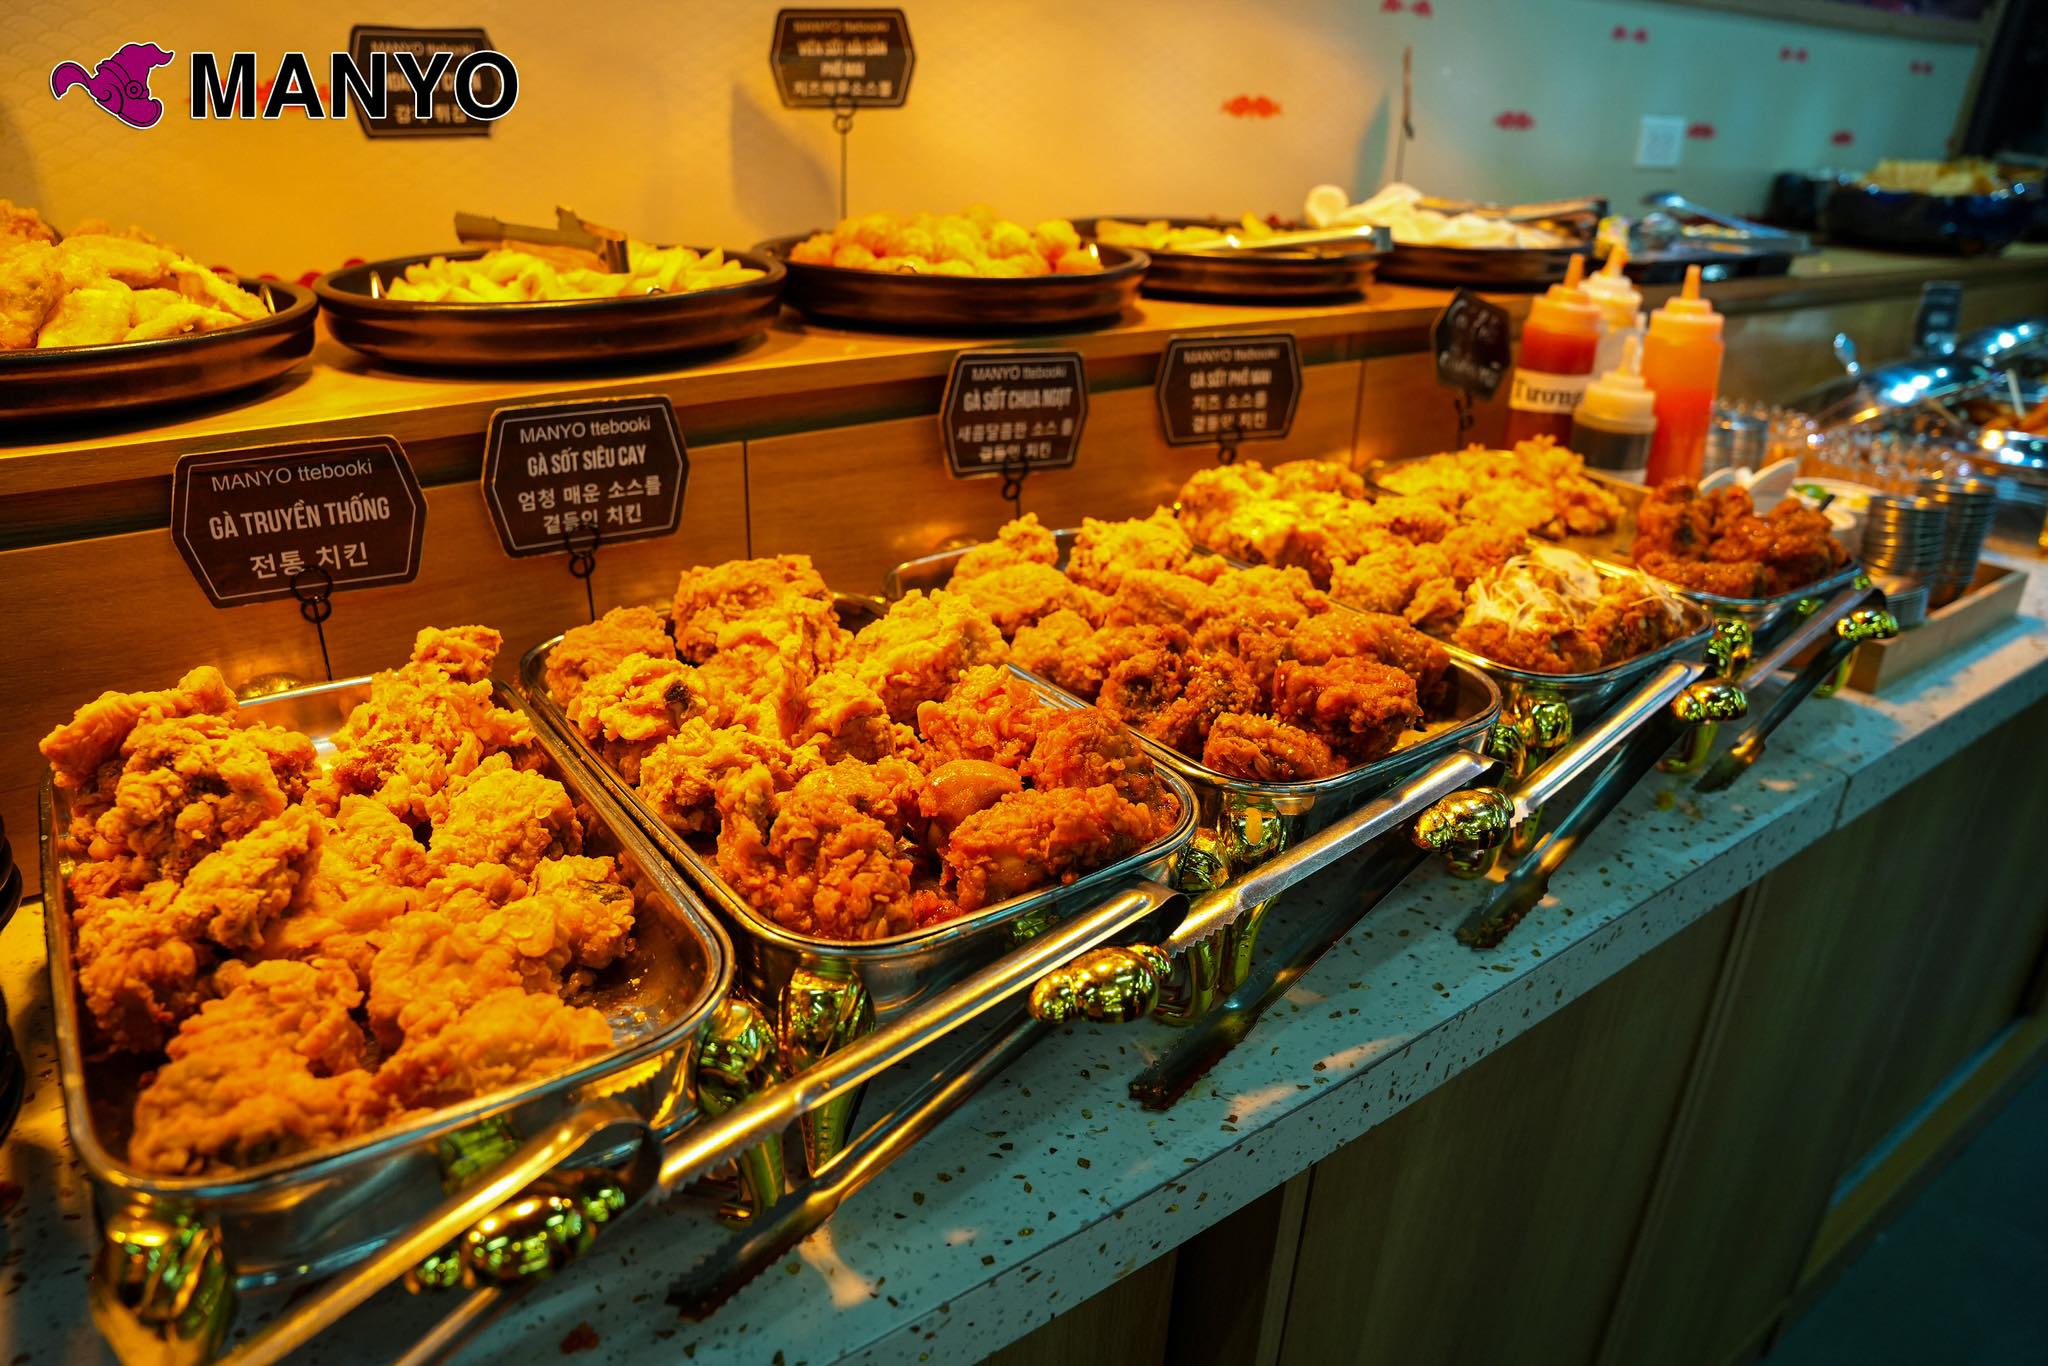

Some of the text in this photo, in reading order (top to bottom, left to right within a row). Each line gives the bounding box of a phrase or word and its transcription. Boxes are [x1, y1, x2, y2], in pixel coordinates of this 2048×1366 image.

[971, 365, 1020, 381] MANYO
[963, 388, 981, 412] GÀ
[982, 386, 1007, 411] SỐT
[520, 415, 651, 444] MANYO ttebooki
[211, 458, 373, 492] MANYO ttebooki
[527, 444, 647, 477] GÀ SỐT SIÊU CAY
[518, 475, 661, 512] 엄청 매운 소스를
[209, 493, 391, 541] GÀ TRUYỀN THỐNG
[606, 503, 642, 525] 치킨
[250, 542, 368, 579] 전통 치킨
